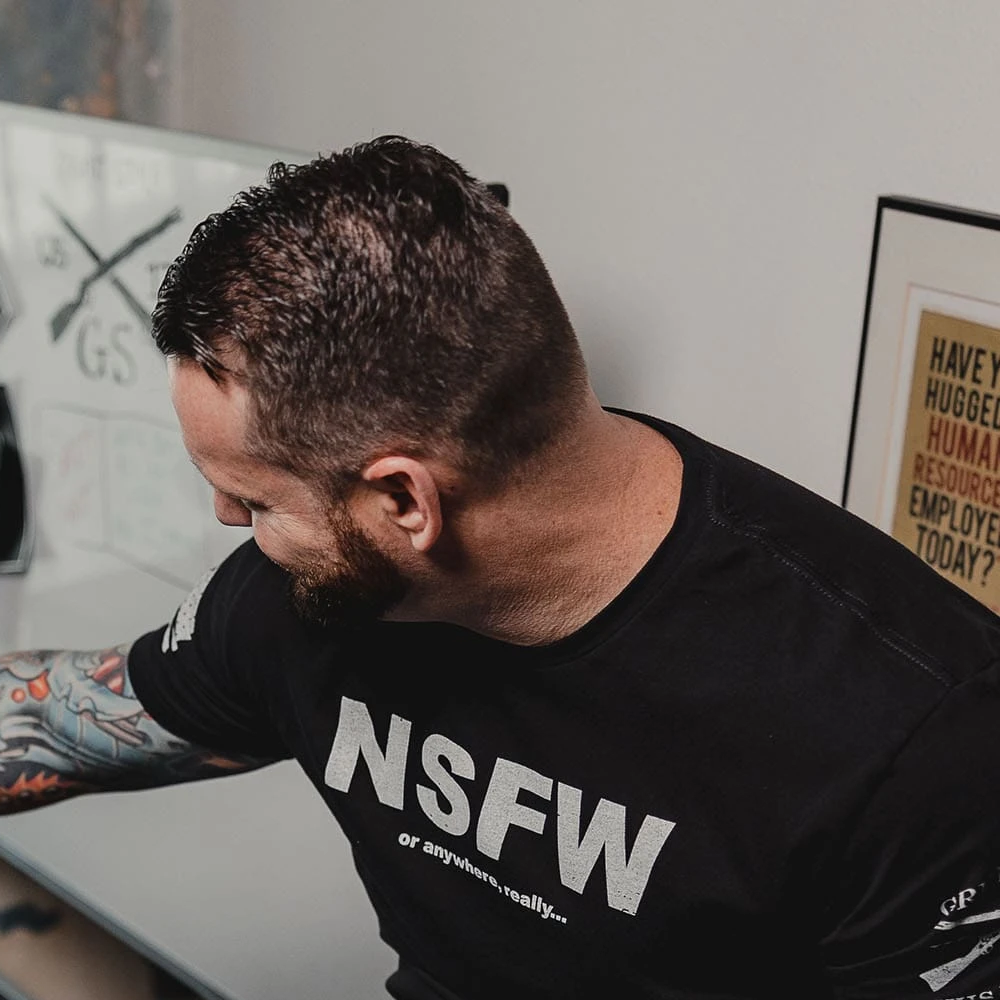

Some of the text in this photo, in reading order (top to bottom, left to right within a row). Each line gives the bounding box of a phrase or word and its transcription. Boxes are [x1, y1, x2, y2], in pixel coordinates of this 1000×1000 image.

[929, 336, 987, 385] HAVE
[908, 484, 1000, 550] EMPLOYE
[916, 523, 995, 588] TODAY?
[324, 695, 677, 916] NSFW
[398, 832, 568, 924] or anywhere, really...
